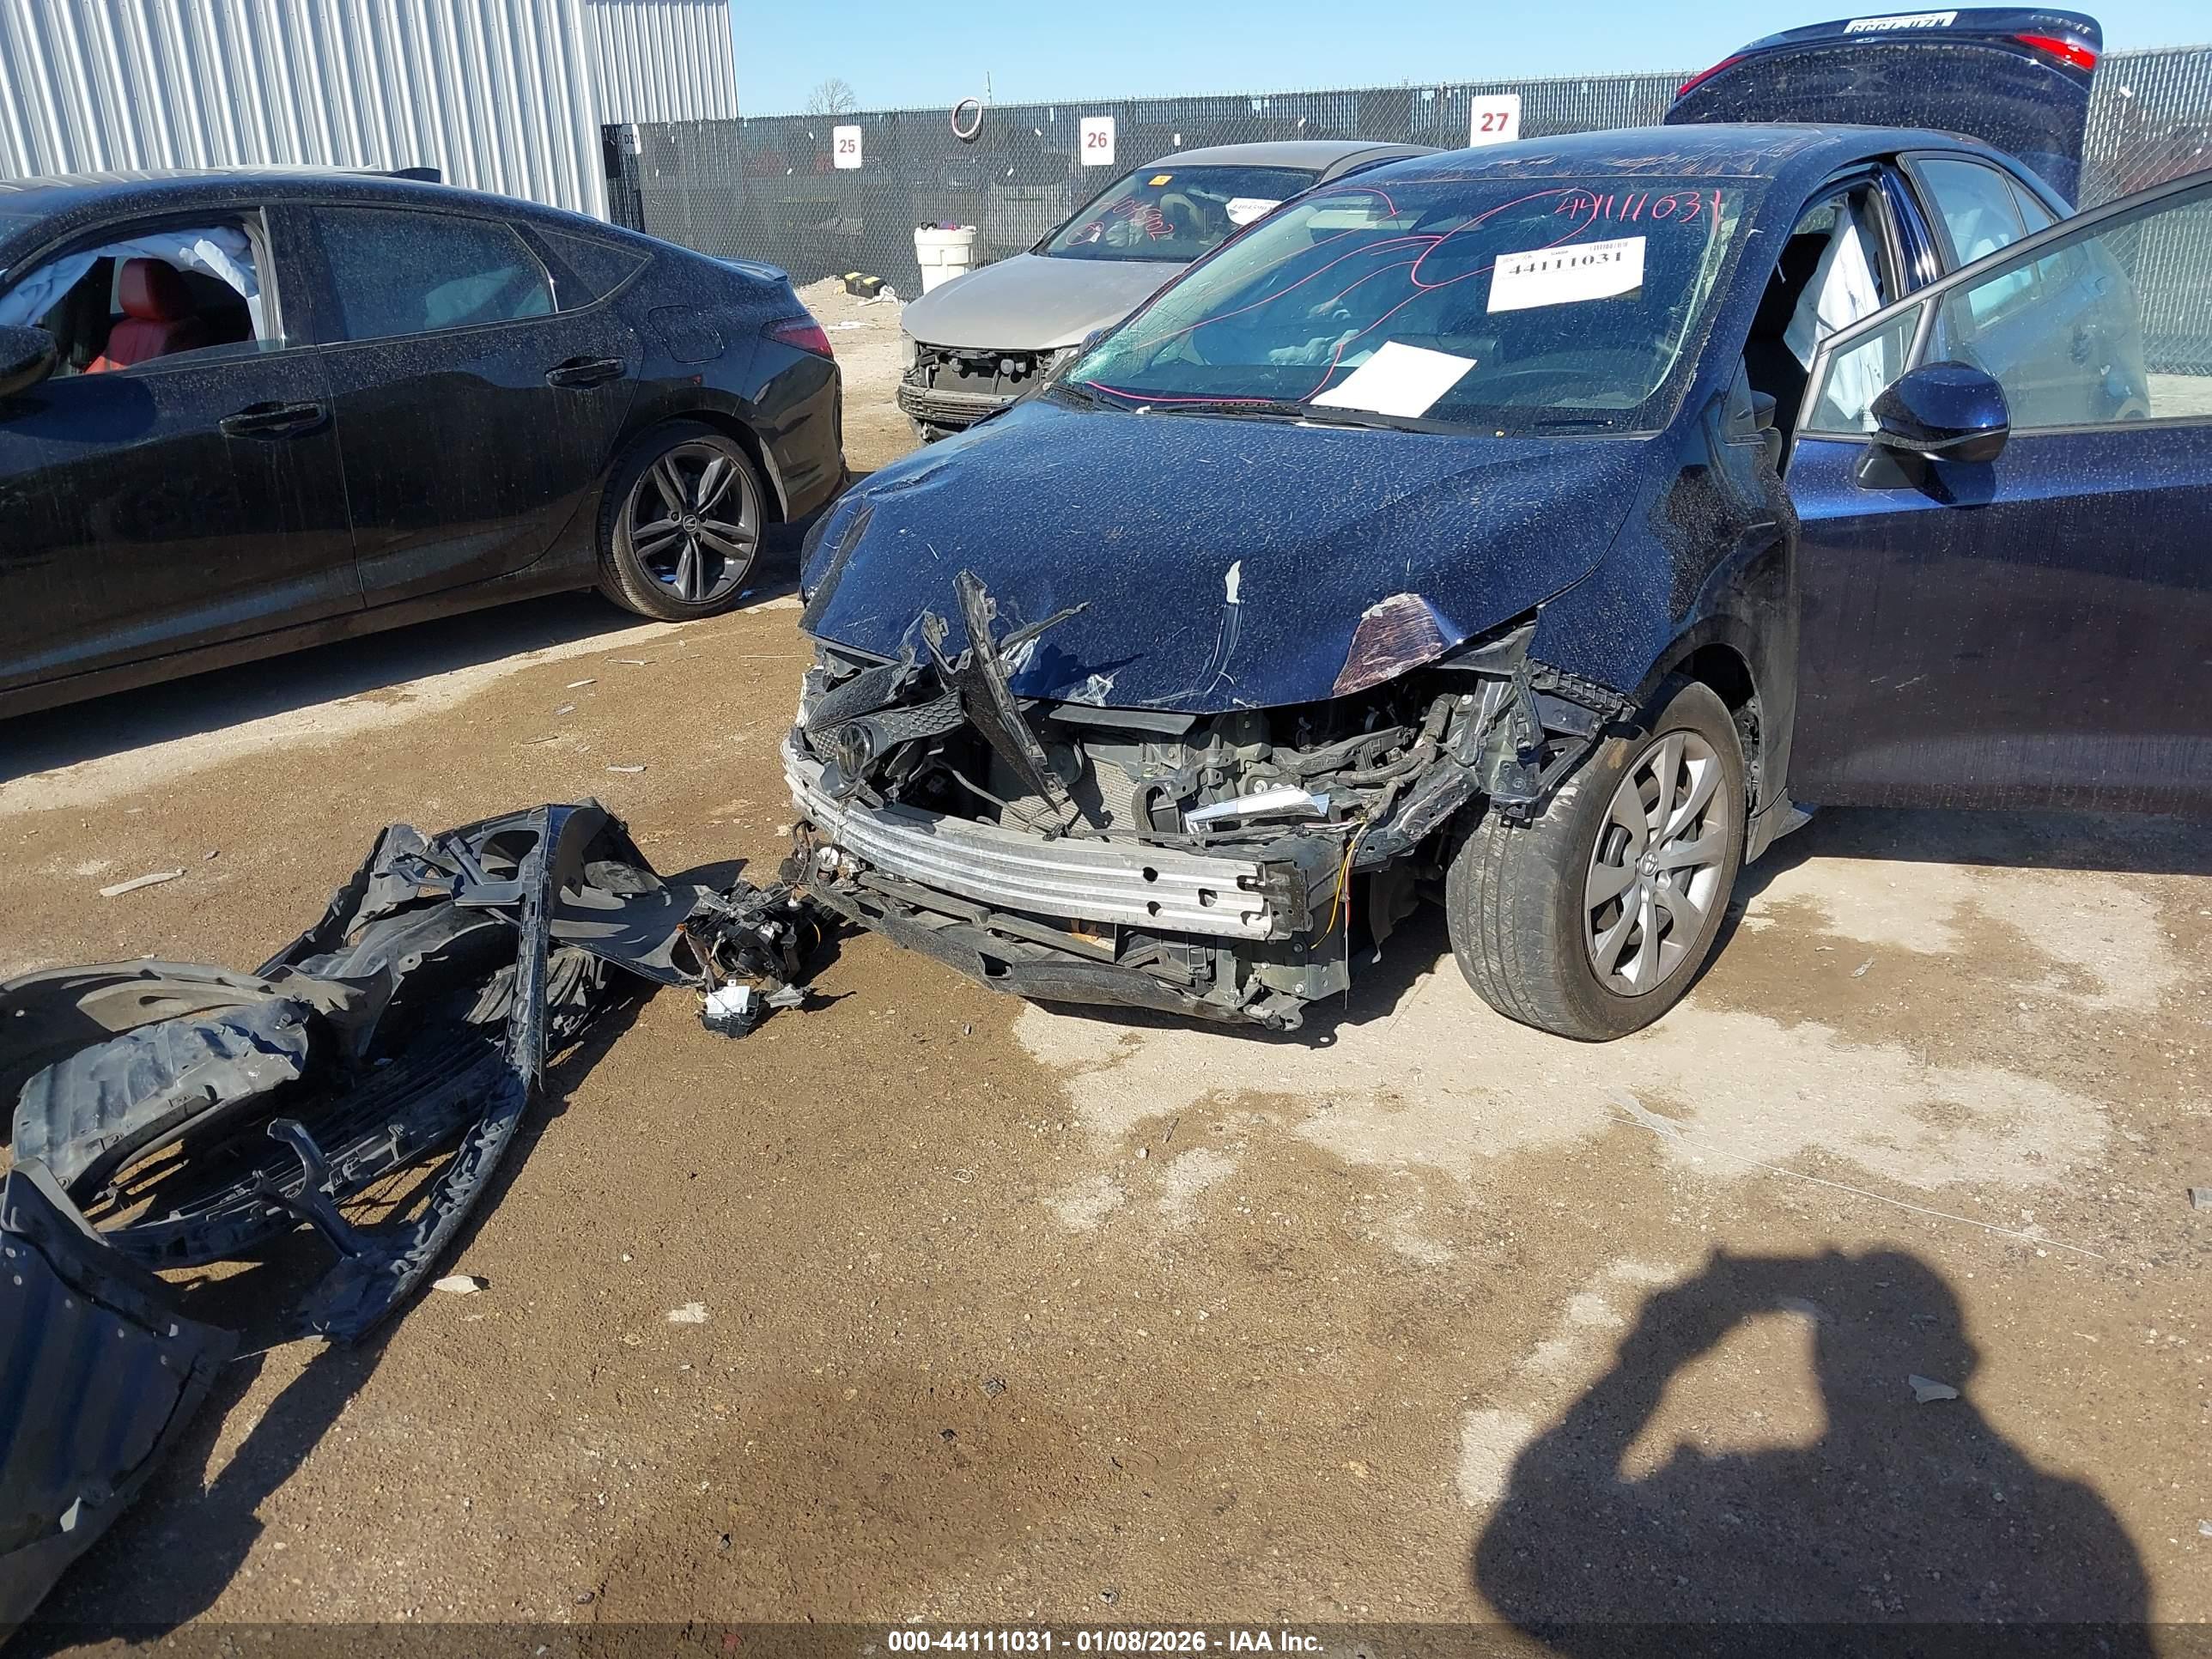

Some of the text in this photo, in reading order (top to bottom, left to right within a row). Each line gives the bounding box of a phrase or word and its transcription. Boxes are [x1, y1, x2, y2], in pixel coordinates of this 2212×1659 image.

[1481, 112, 1509, 131] 27
[839, 139, 856, 154] 25
[1087, 131, 1108, 149] 26
[1554, 191, 1721, 223] 44111031
[1509, 252, 1621, 275] 44111031
